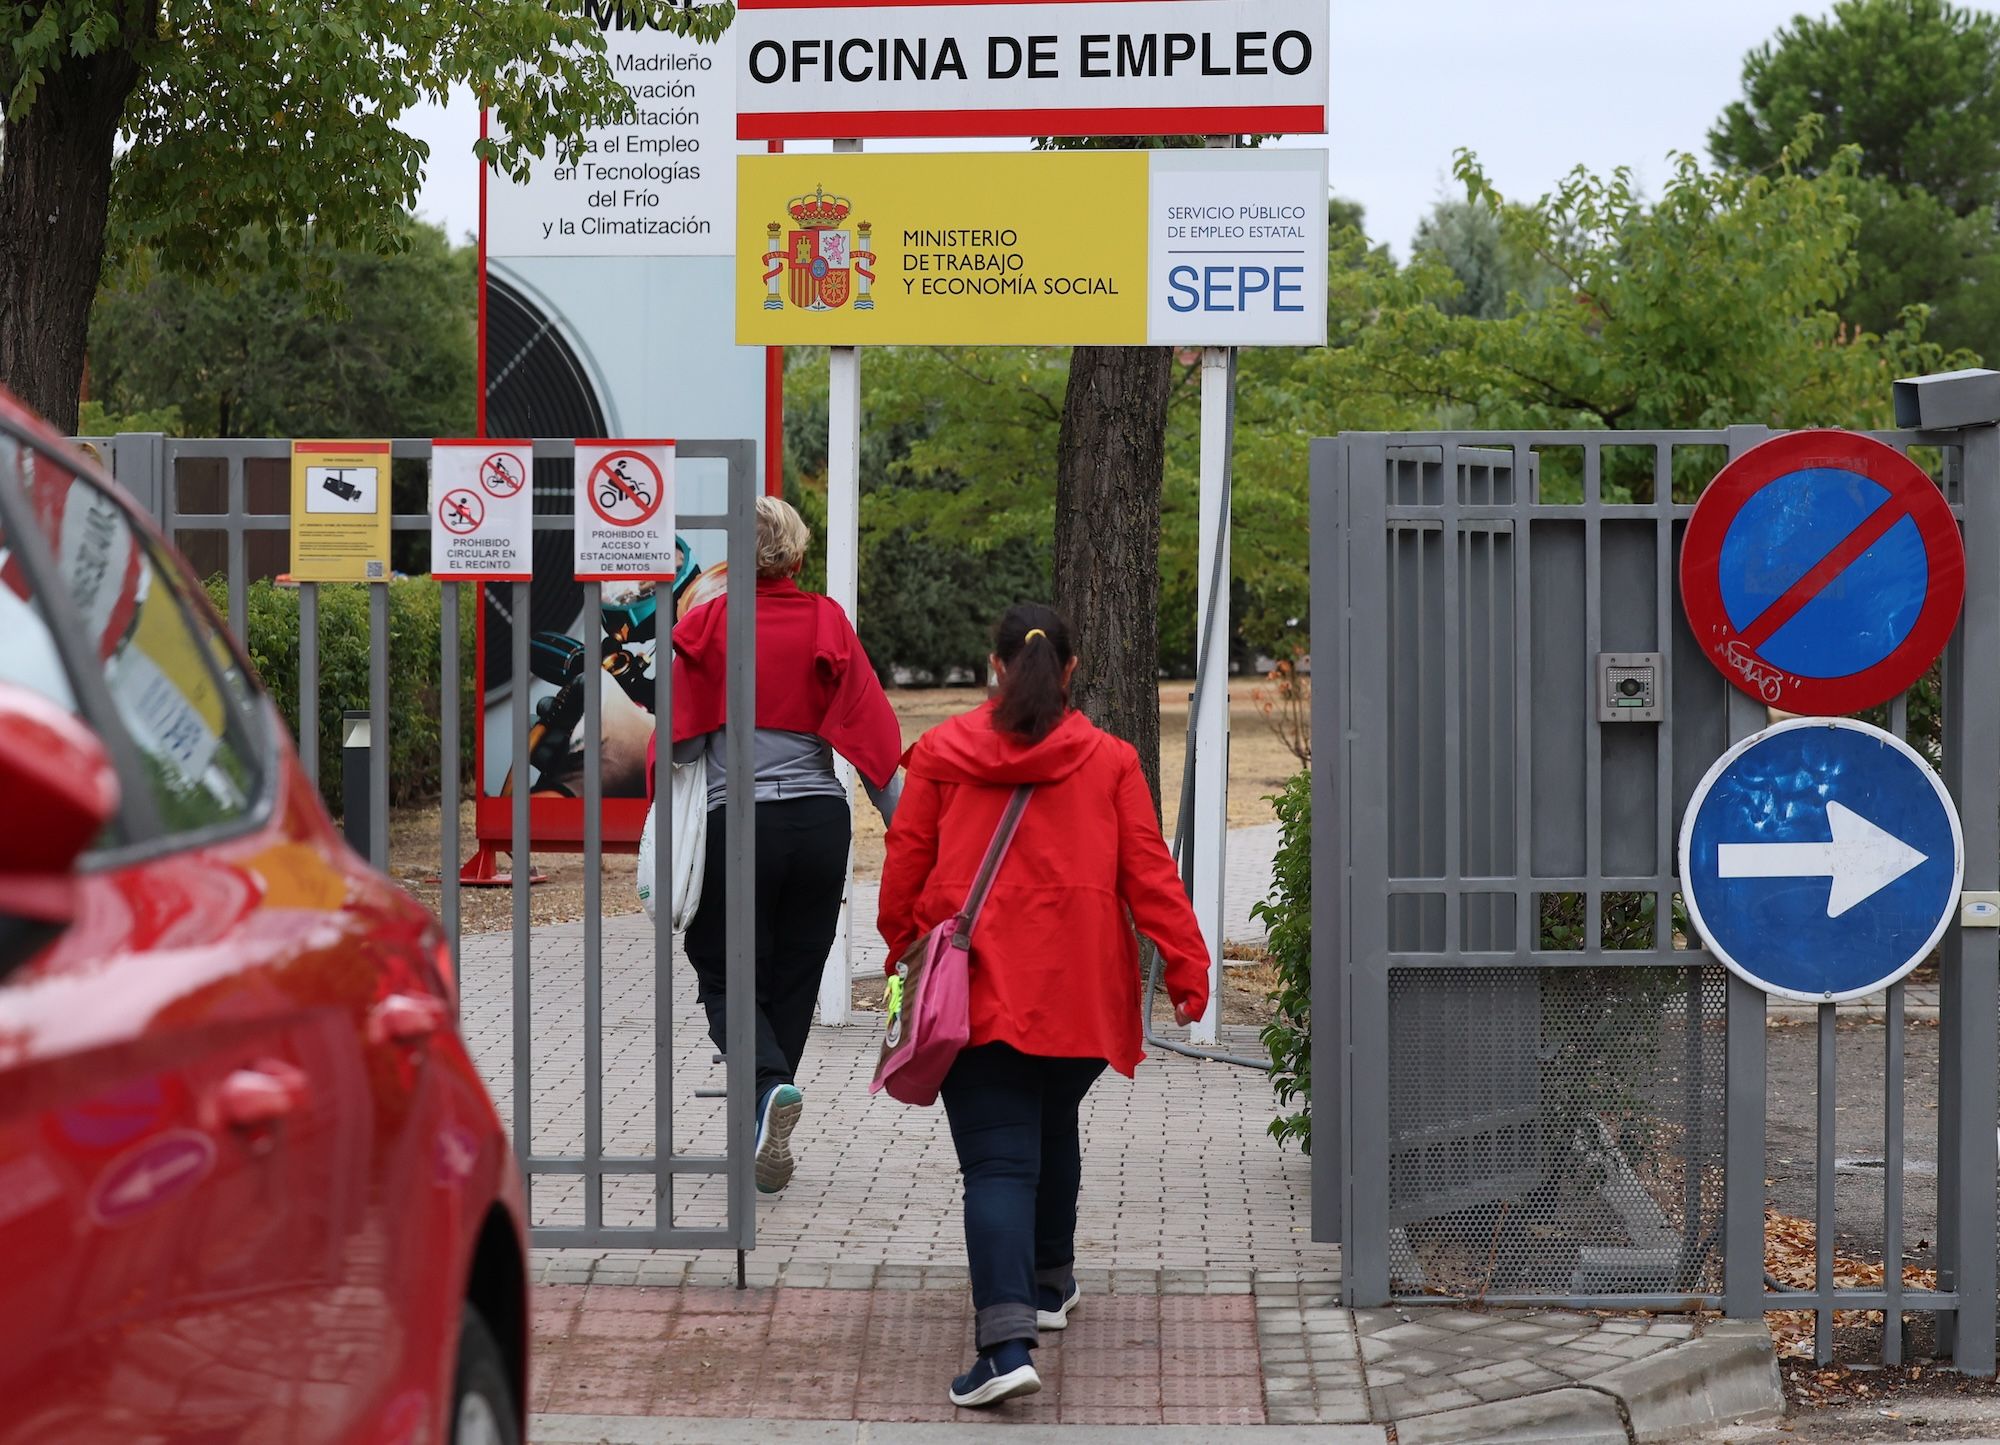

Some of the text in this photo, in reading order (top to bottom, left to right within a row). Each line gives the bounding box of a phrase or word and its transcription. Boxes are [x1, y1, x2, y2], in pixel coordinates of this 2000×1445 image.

[616, 53, 712, 72] Madrileño
[749, 30, 1312, 84] OFICINA DE EMPLEO
[603, 135, 619, 154] el
[626, 135, 700, 157] Empleo
[554, 160, 701, 185] en Tecnologías
[587, 189, 660, 208] del Frío
[1168, 203, 1306, 220] SERVICIO PÚBLICO
[542, 215, 711, 240] y la Climatización
[1168, 225, 1305, 238] DE EMPLEO ESTATAL
[903, 229, 1018, 247] MINISTERIO
[903, 253, 1024, 276] DE TRABAJO
[902, 273, 1119, 295] Y ECONOMÍA SOCIAL
[1167, 265, 1305, 313] SEPE
[452, 538, 511, 548] PROHIBIDO
[592, 530, 659, 539] PROHIBIDO EL
[447, 549, 517, 559] CIRCULAR EN
[601, 541, 650, 550] ACCESO Y
[449, 560, 511, 569] EL RECINTO
[580, 552, 671, 561] ESTACIONAMIENTO
[600, 563, 651, 572] DE MOTOS
